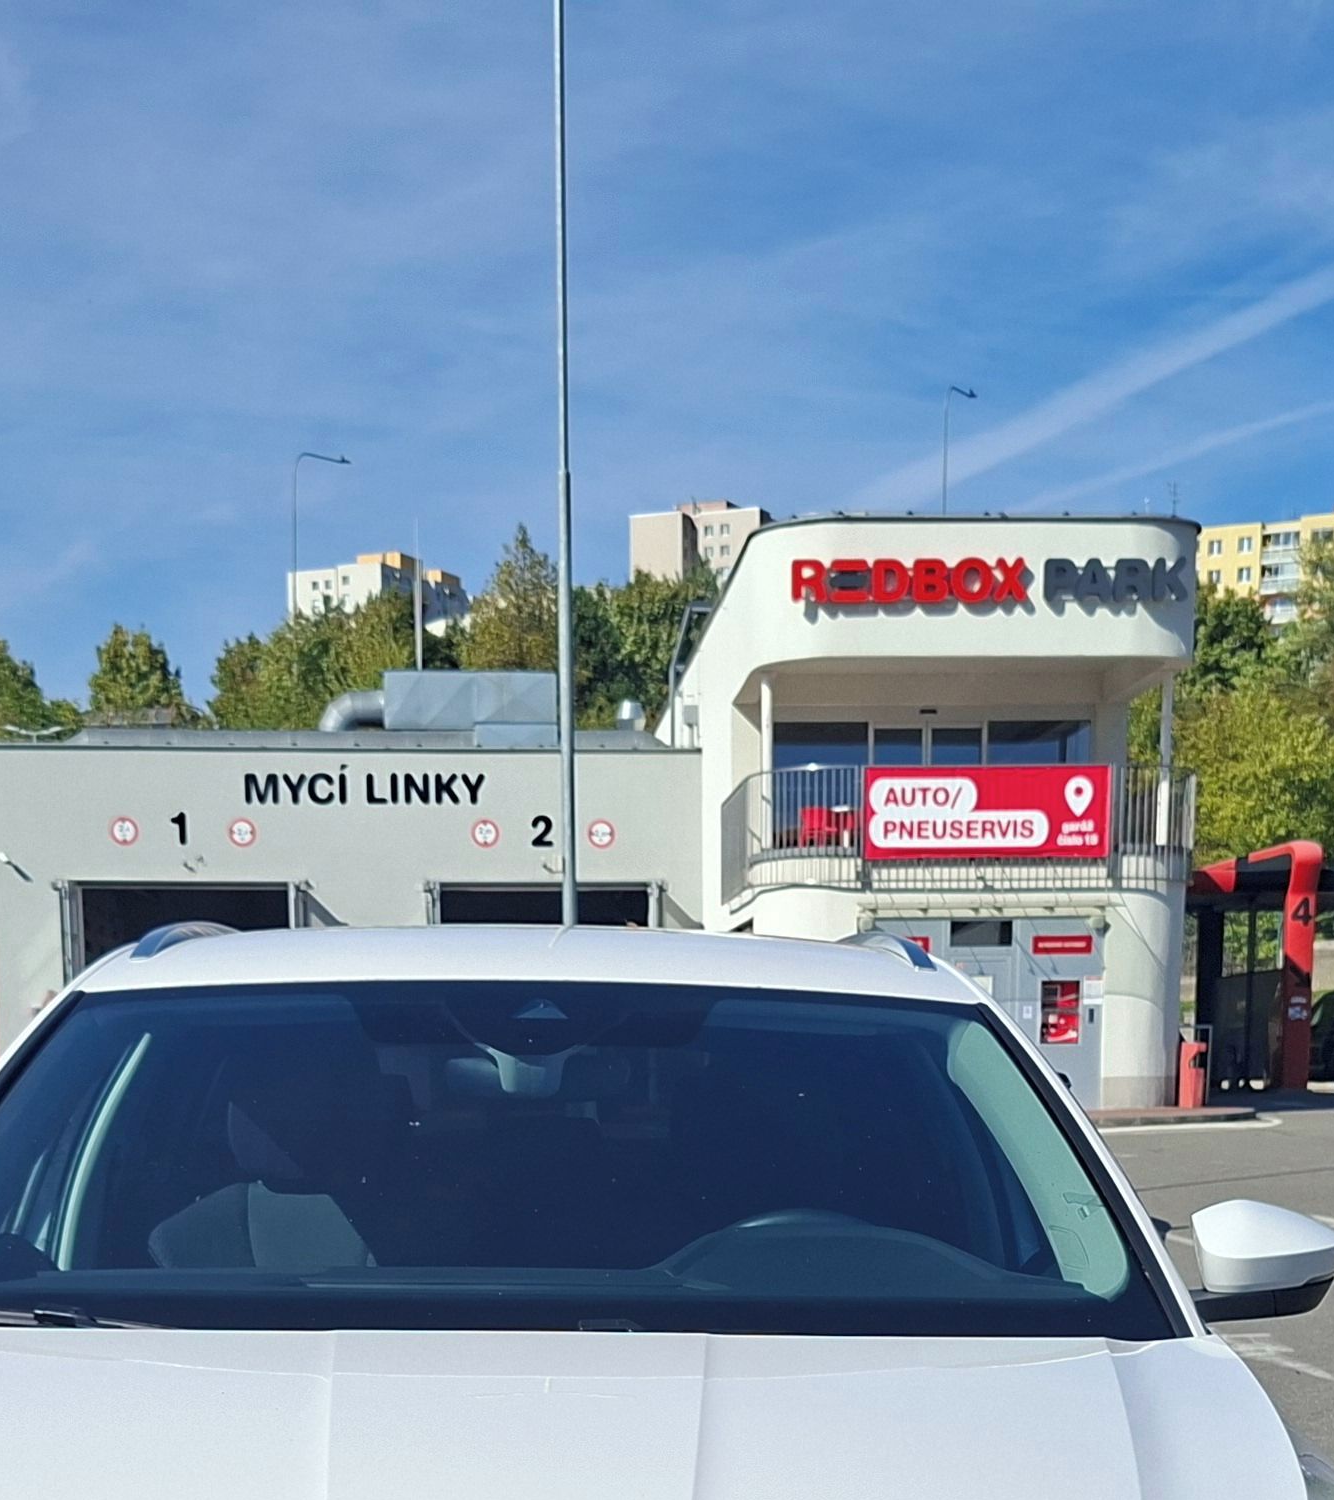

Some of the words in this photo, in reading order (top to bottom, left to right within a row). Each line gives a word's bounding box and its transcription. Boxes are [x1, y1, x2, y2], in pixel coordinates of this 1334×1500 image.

[791, 557, 1029, 604] REDBOX
[1044, 557, 1188, 601] PARK
[244, 763, 348, 805] MYCÍ
[366, 772, 486, 805] LINKY
[883, 786, 963, 809] AUTO/
[170, 811, 187, 845] 1
[531, 815, 554, 847] 2
[883, 819, 1035, 840] PNEUSERVIS
[1291, 896, 1312, 926] 4
